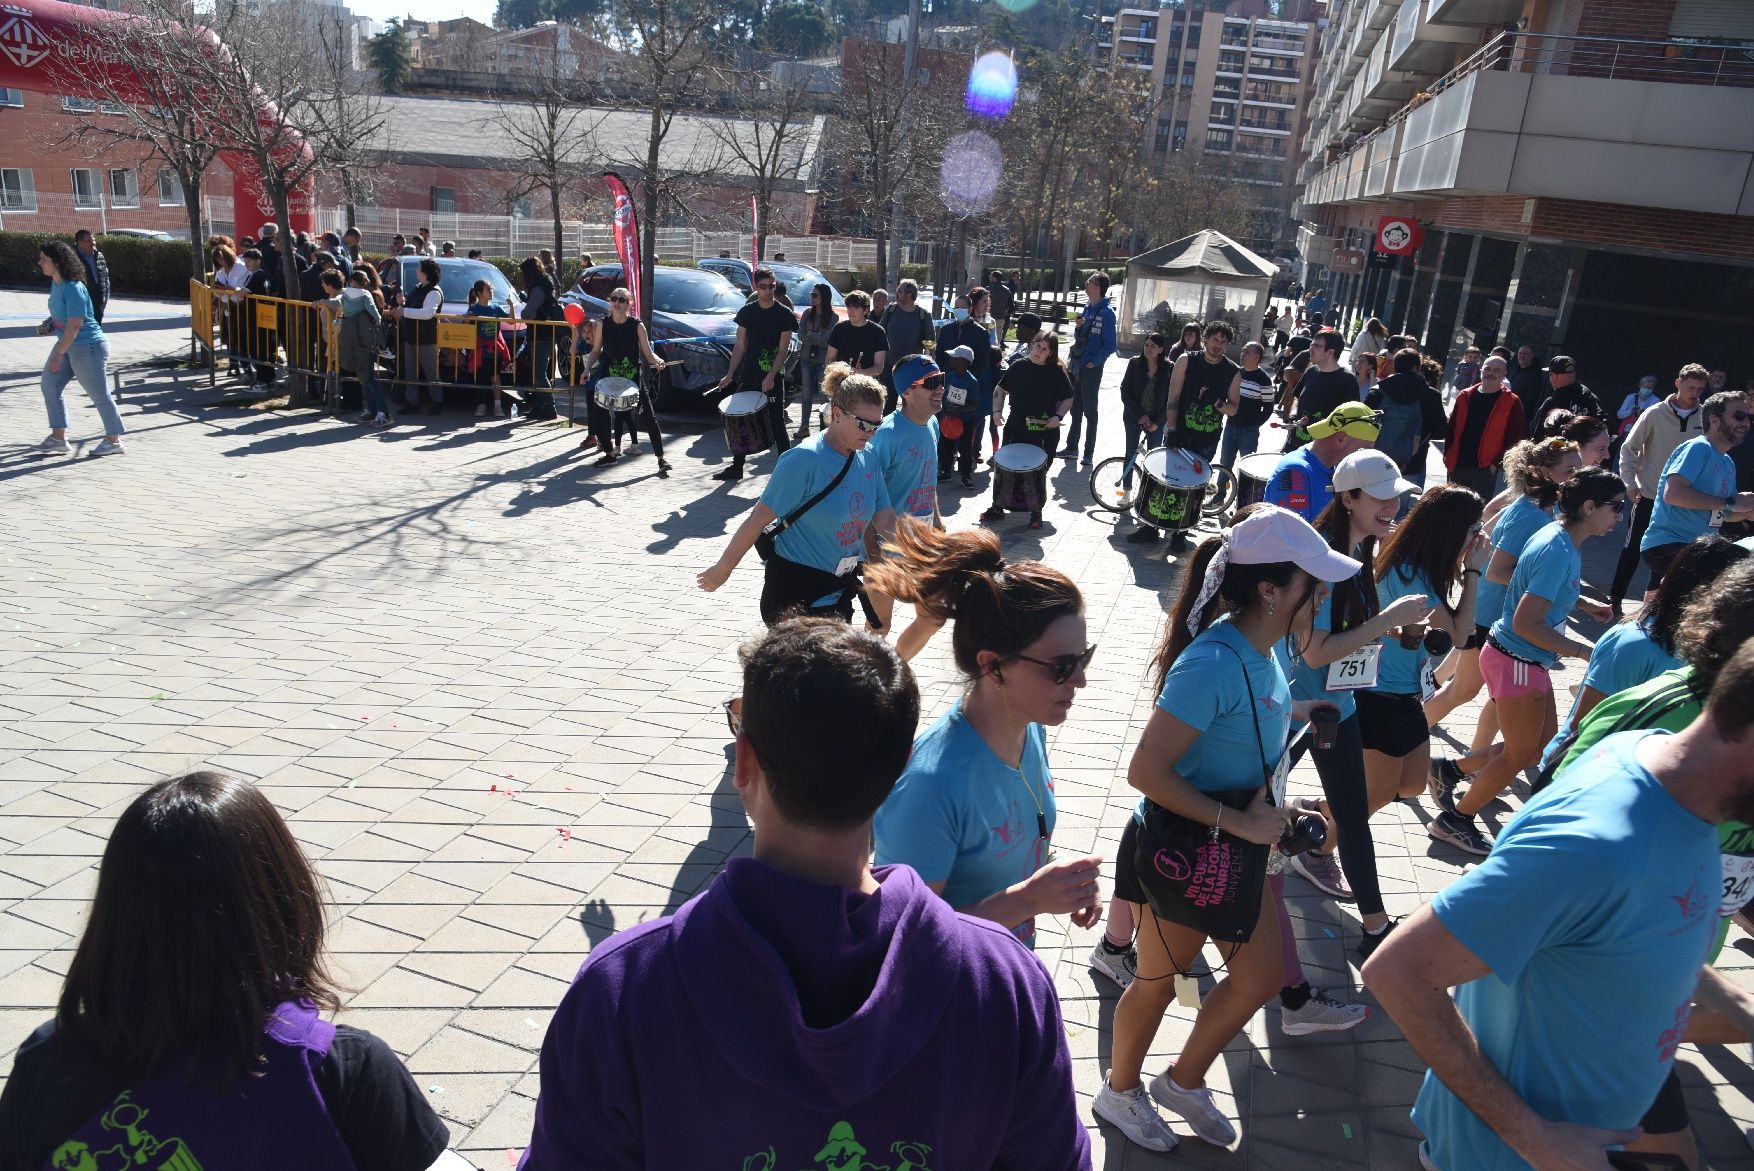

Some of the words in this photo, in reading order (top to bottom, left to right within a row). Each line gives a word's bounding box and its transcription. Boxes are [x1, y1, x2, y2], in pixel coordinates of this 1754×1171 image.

[1340, 659, 1367, 678] 751
[1193, 845, 1208, 884] CURSA
[1209, 842, 1231, 905] MANRESA
[1194, 893, 1210, 908] DE
[1202, 877, 1217, 892] LA
[1722, 876, 1754, 900] 34
